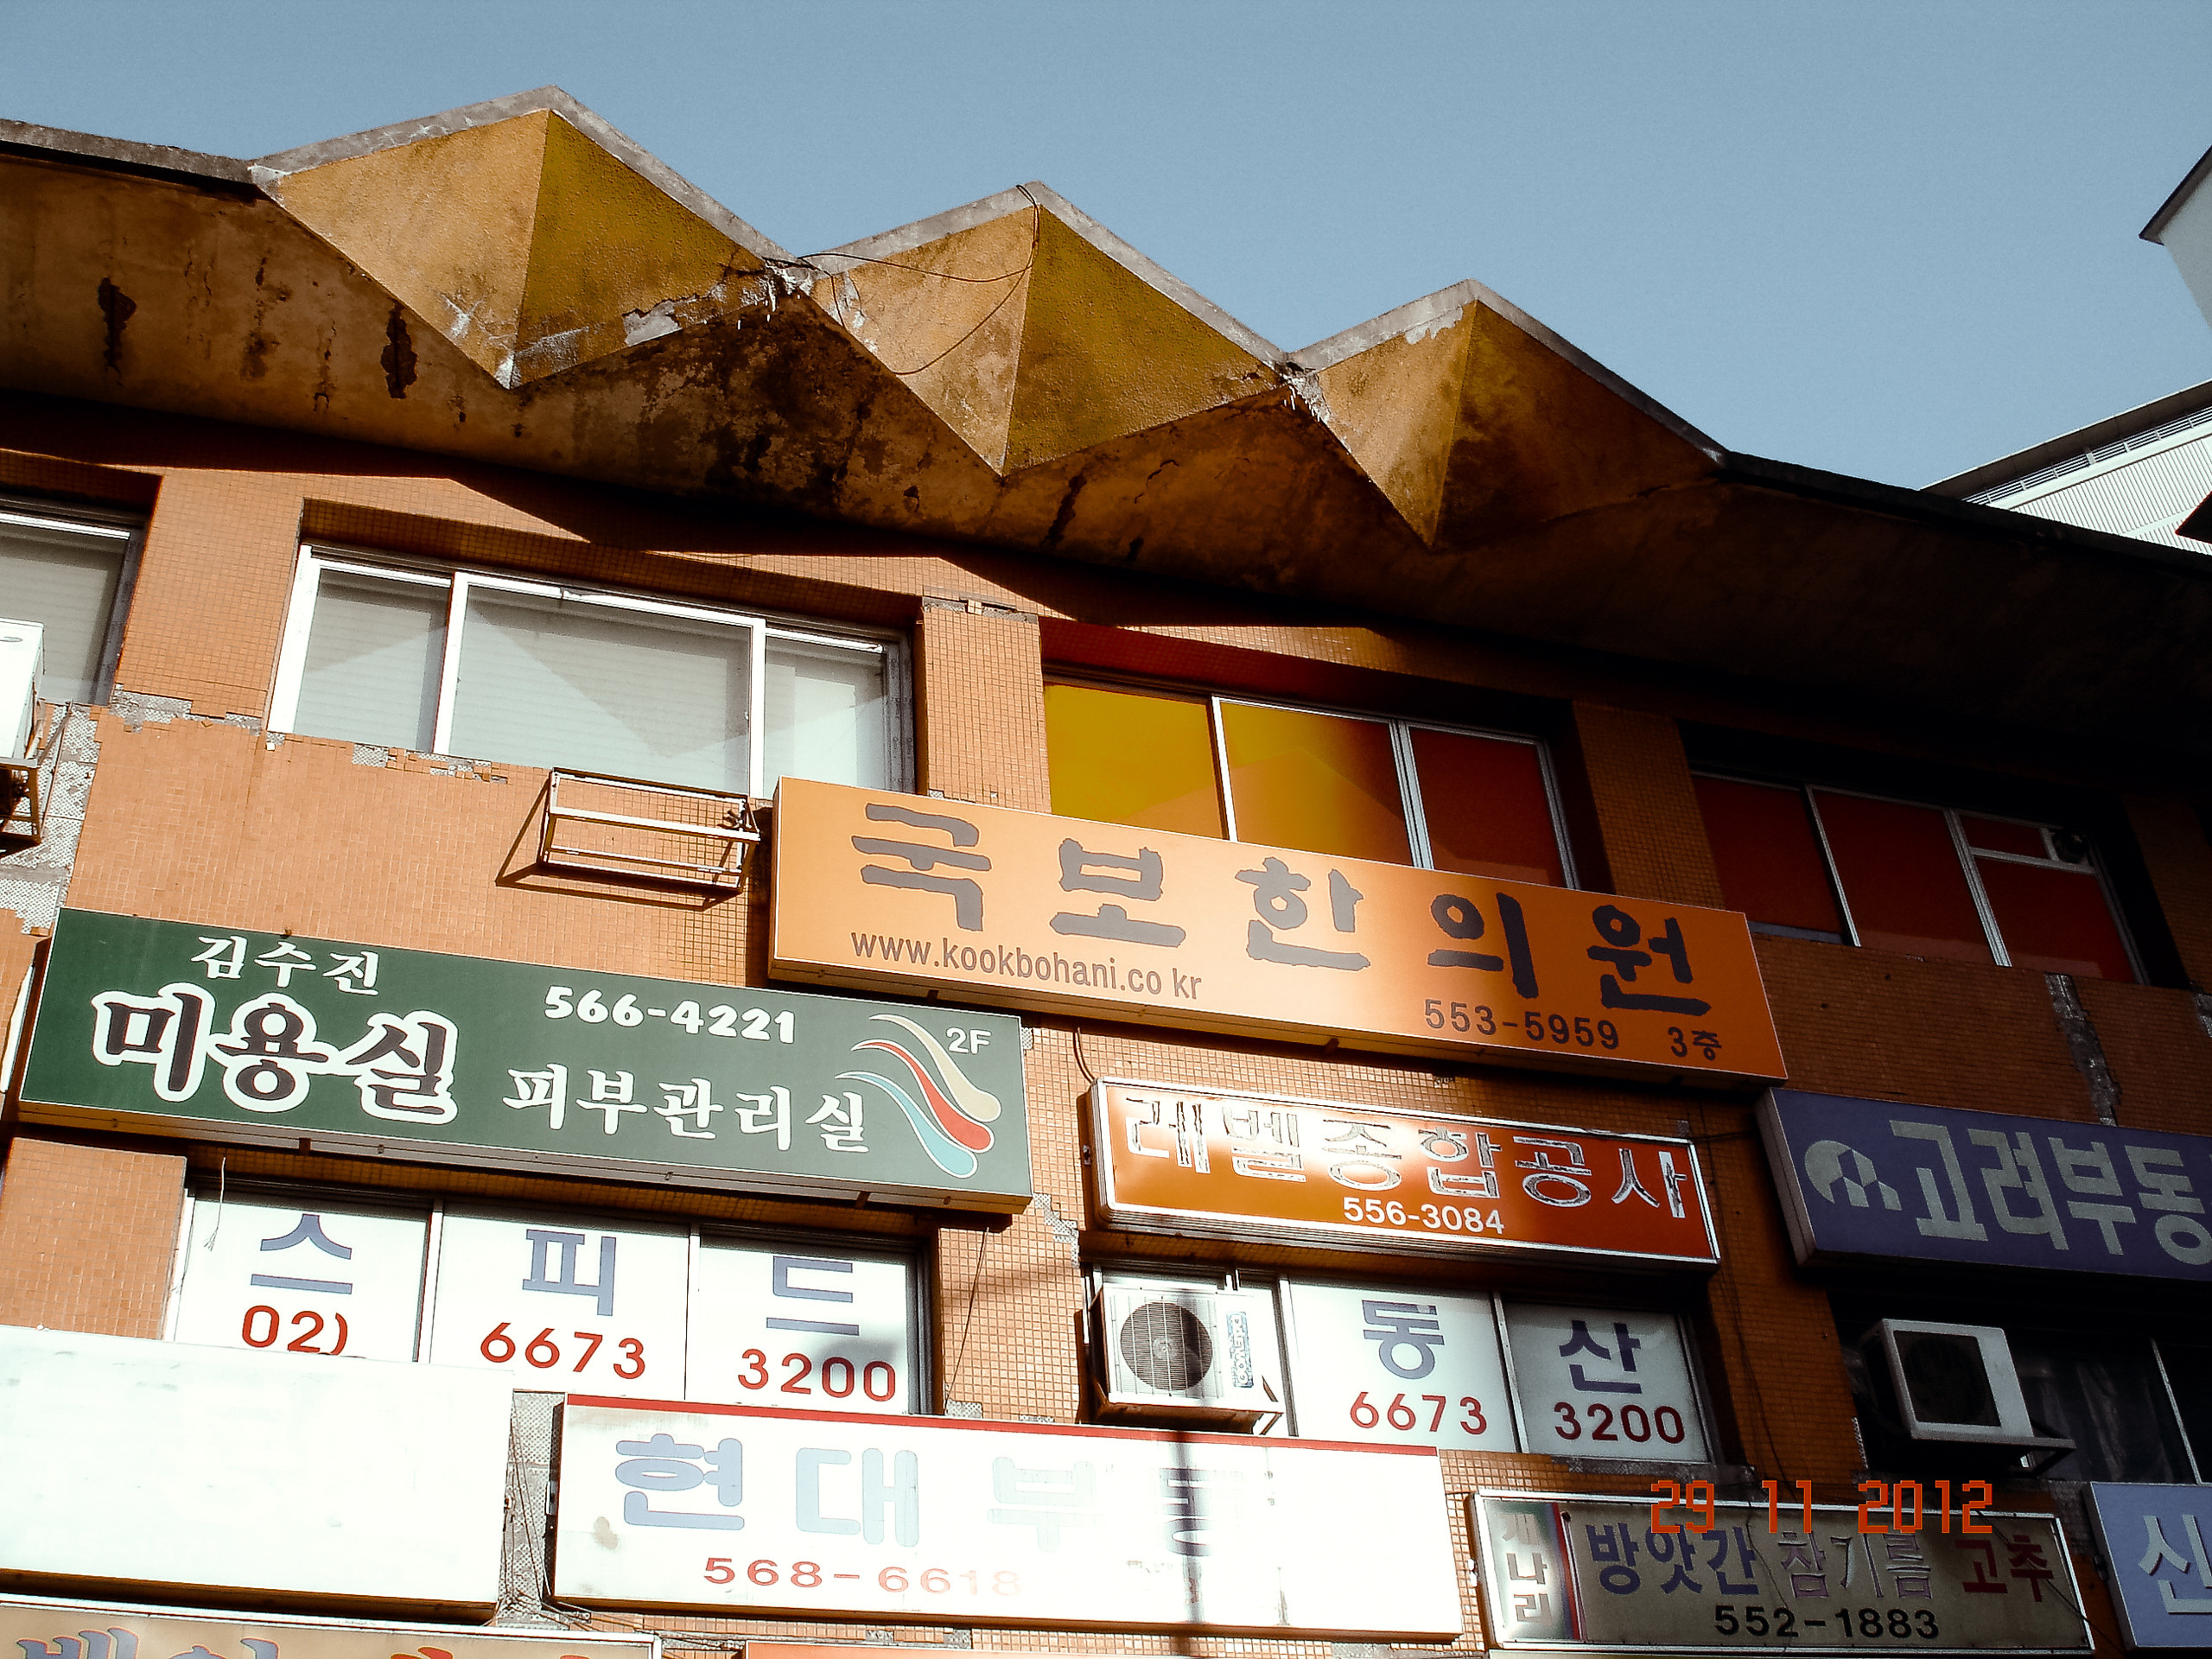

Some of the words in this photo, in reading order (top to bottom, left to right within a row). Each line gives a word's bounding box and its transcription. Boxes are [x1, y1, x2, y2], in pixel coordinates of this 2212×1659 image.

[850, 802, 1712, 1016] 국보한의원
[191, 936, 380, 996] 김수진
[544, 986, 795, 1044] 566-4221
[945, 1027, 992, 1054] 2F
[1424, 999, 1619, 1050] 553-5959
[1669, 1027, 1722, 1061] 3층
[92, 982, 458, 1124] 미용실
[502, 1064, 869, 1153] 피부관리실
[1125, 1096, 1688, 1219] 레벨종합공사
[1342, 1196, 1505, 1236] 556-3084
[1889, 1120, 2212, 1266] 고려부동
[241, 1305, 348, 1356] 02)
[480, 1322, 647, 1380] 6673
[738, 1348, 897, 1402] 3200
[1350, 1391, 1487, 1435] 6673
[1554, 1402, 1685, 1444] 3200
[703, 1557, 1023, 1597] 568-6618
[1586, 1522, 1759, 1596] 방앗간
[1777, 1530, 1933, 1599] 참기름
[1955, 1535, 2054, 1602] 고추
[1715, 1605, 1939, 1640] 552-1883
